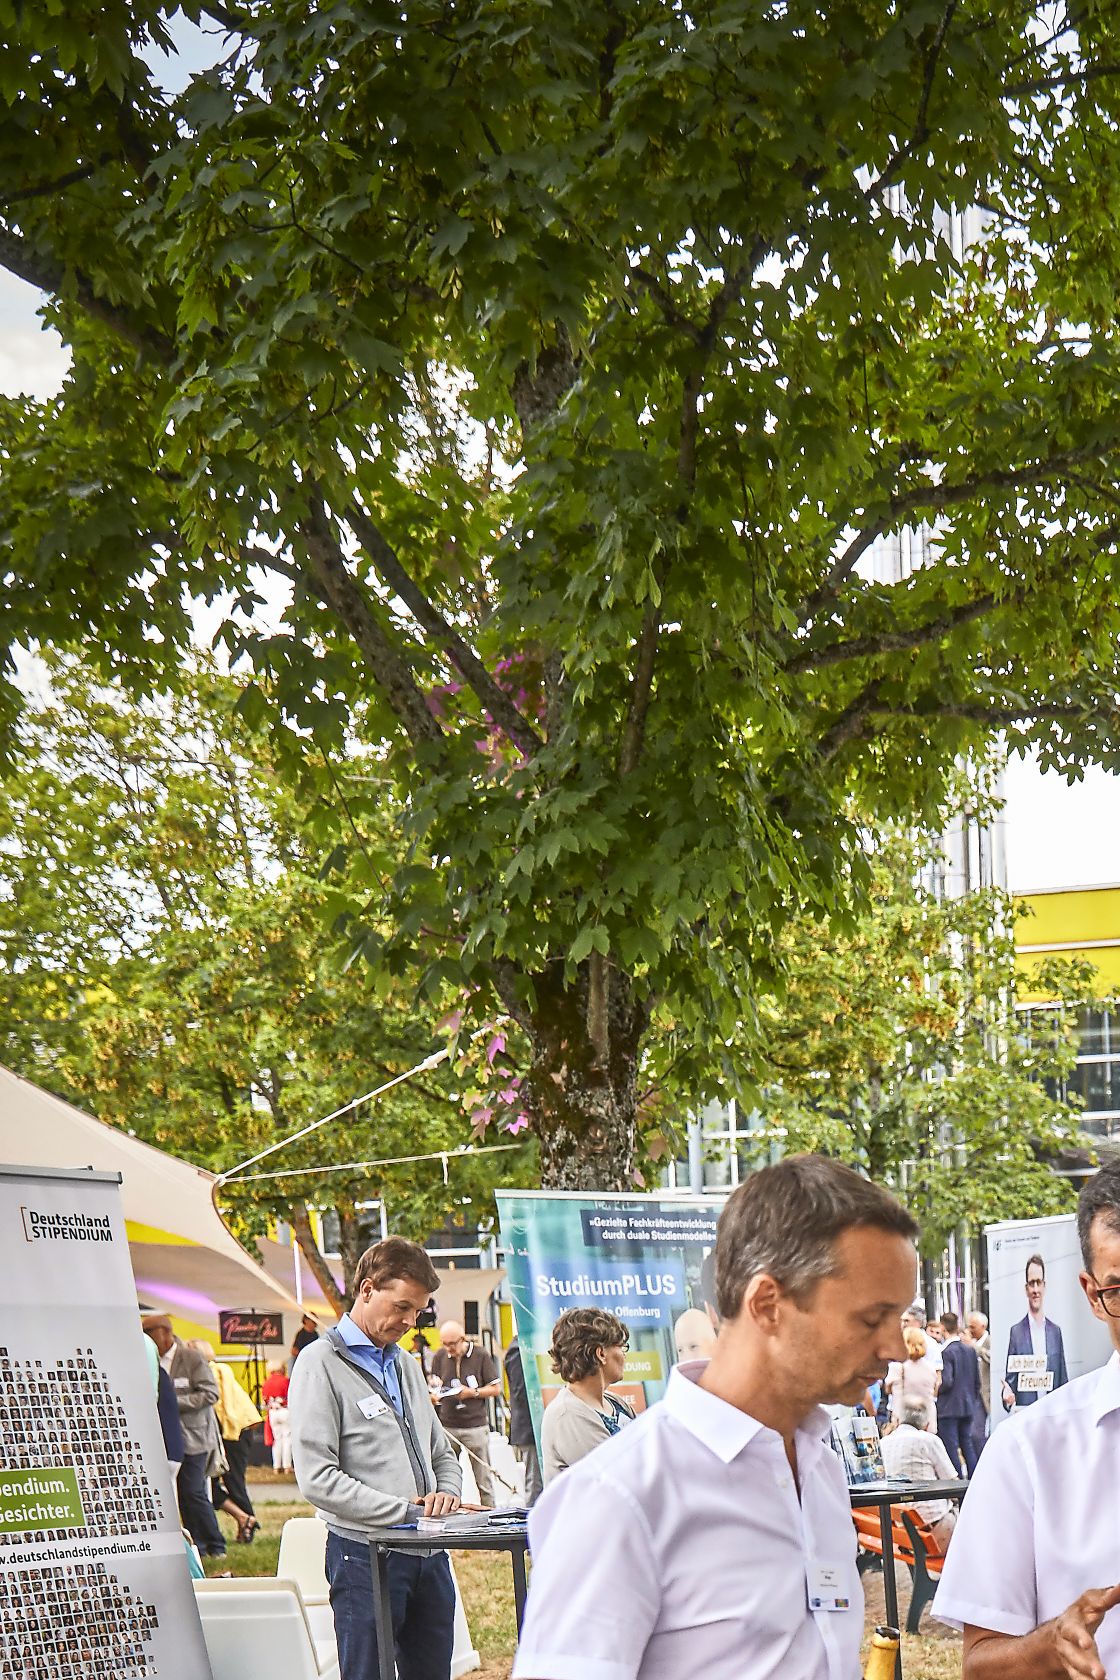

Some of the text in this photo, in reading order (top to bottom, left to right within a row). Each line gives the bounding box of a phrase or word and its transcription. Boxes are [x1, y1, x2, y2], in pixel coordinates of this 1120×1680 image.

[29, 1211, 110, 1228] Deutschland
[32, 1226, 113, 1242] STIPENDIUM
[602, 1230, 626, 1240] durch
[628, 1230, 650, 1240] duale
[537, 1274, 677, 1297] StudiumPLUS
[615, 1306, 661, 1318] Offenburg
[0, 1477, 70, 1498] endium.
